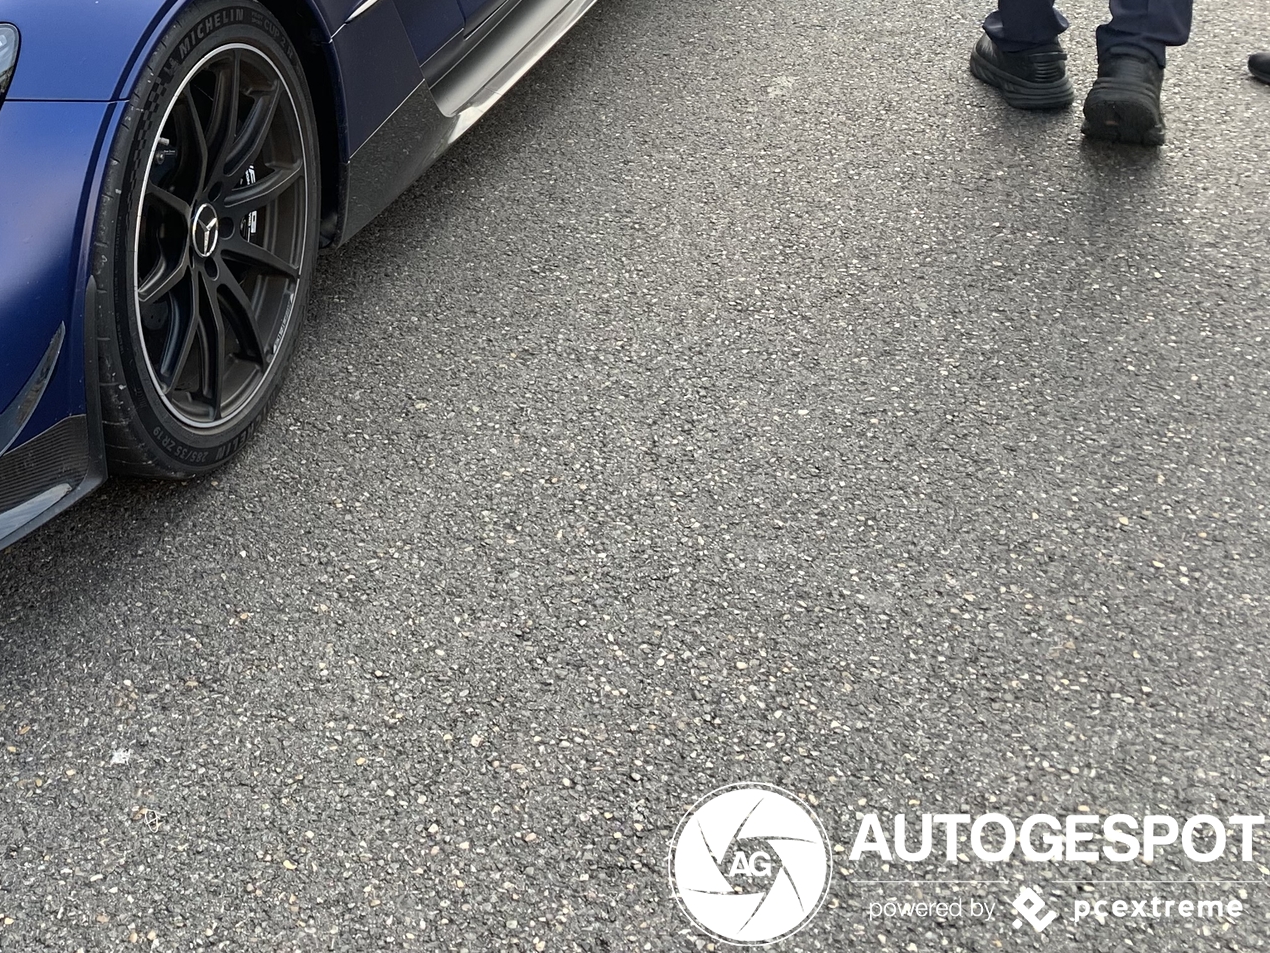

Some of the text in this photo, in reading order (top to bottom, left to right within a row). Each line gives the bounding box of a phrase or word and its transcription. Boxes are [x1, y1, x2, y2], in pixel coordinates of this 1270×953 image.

[179, 8, 244, 60] MICHELIN
[263, 20, 279, 38] CUP
[174, 446, 209, 463] 285/35
